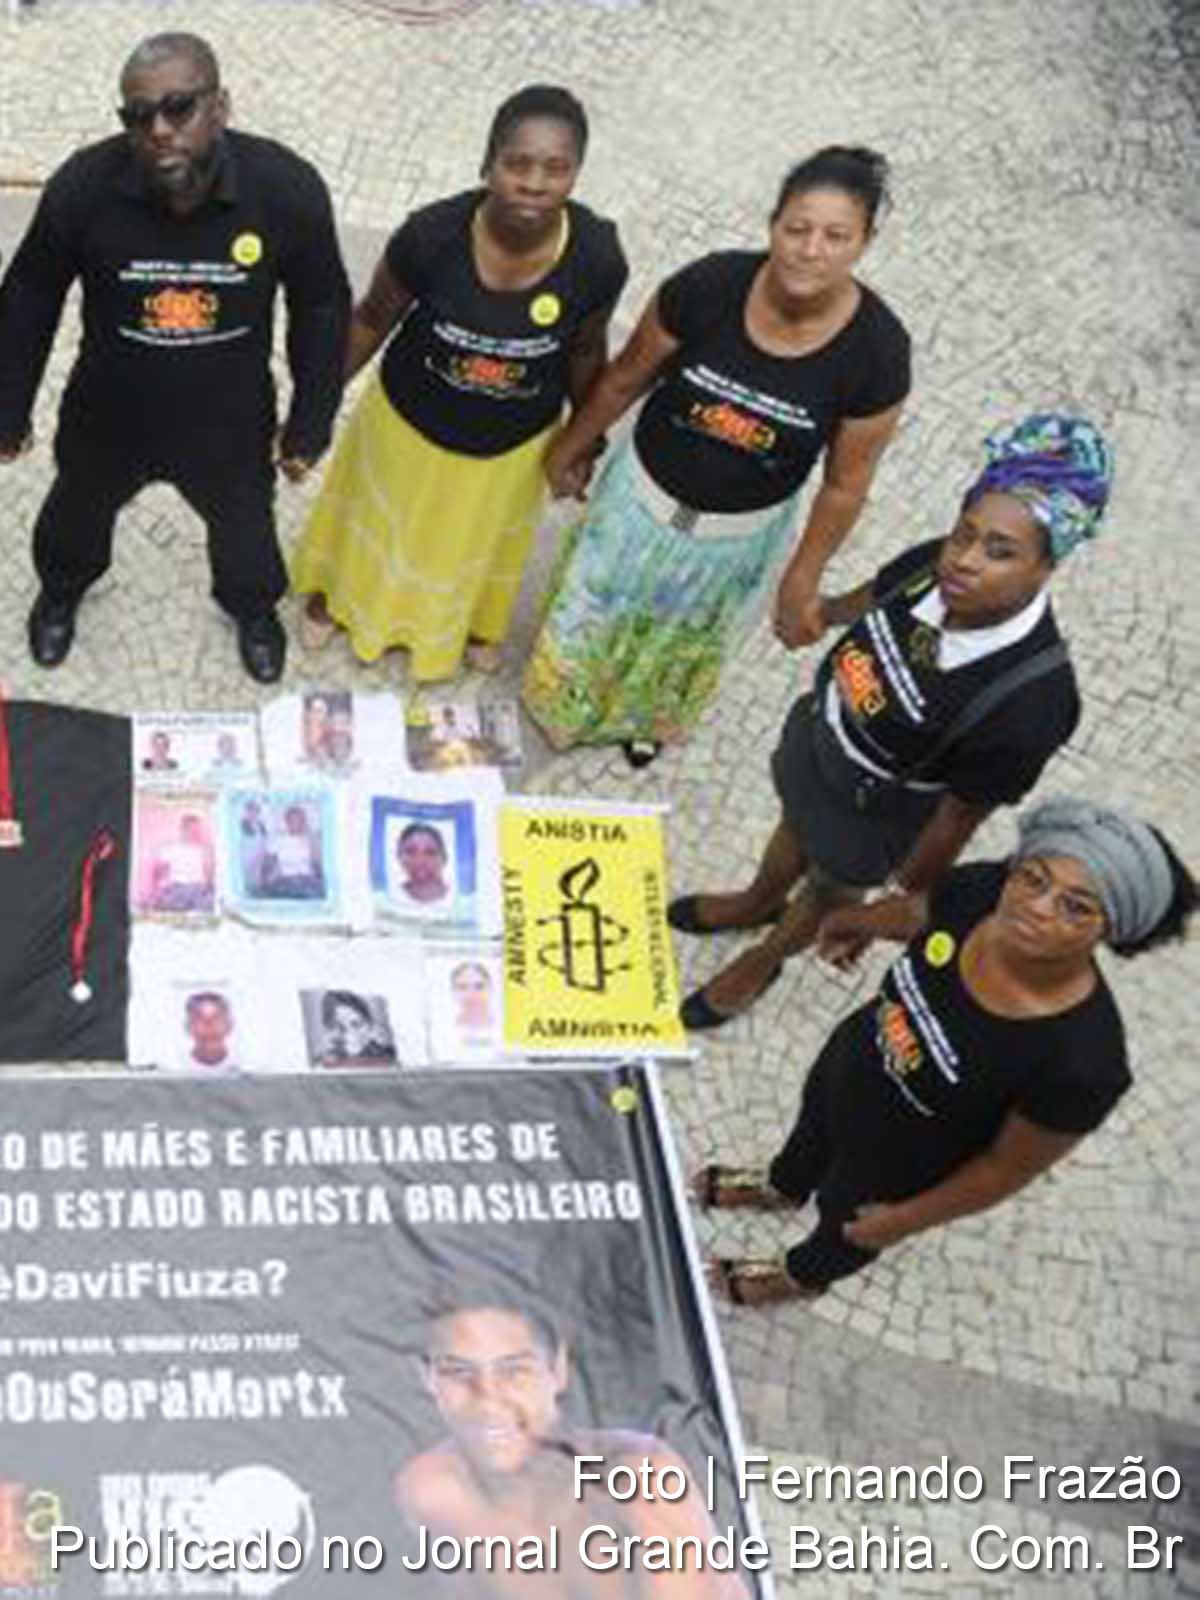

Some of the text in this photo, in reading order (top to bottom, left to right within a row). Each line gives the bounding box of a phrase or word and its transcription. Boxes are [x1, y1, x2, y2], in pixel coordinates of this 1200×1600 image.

[526, 819, 628, 843] ANISTIA
[41, 1131, 87, 1169] DE
[103, 1122, 211, 1168] MÃES
[226, 1127, 247, 1166] E
[262, 1122, 496, 1166] FAMILIARES
[510, 1122, 560, 1161] DE
[56, 1188, 205, 1229] ESTADO
[221, 1186, 390, 1228] RACISTA
[405, 1180, 642, 1222] BRASILEIRO
